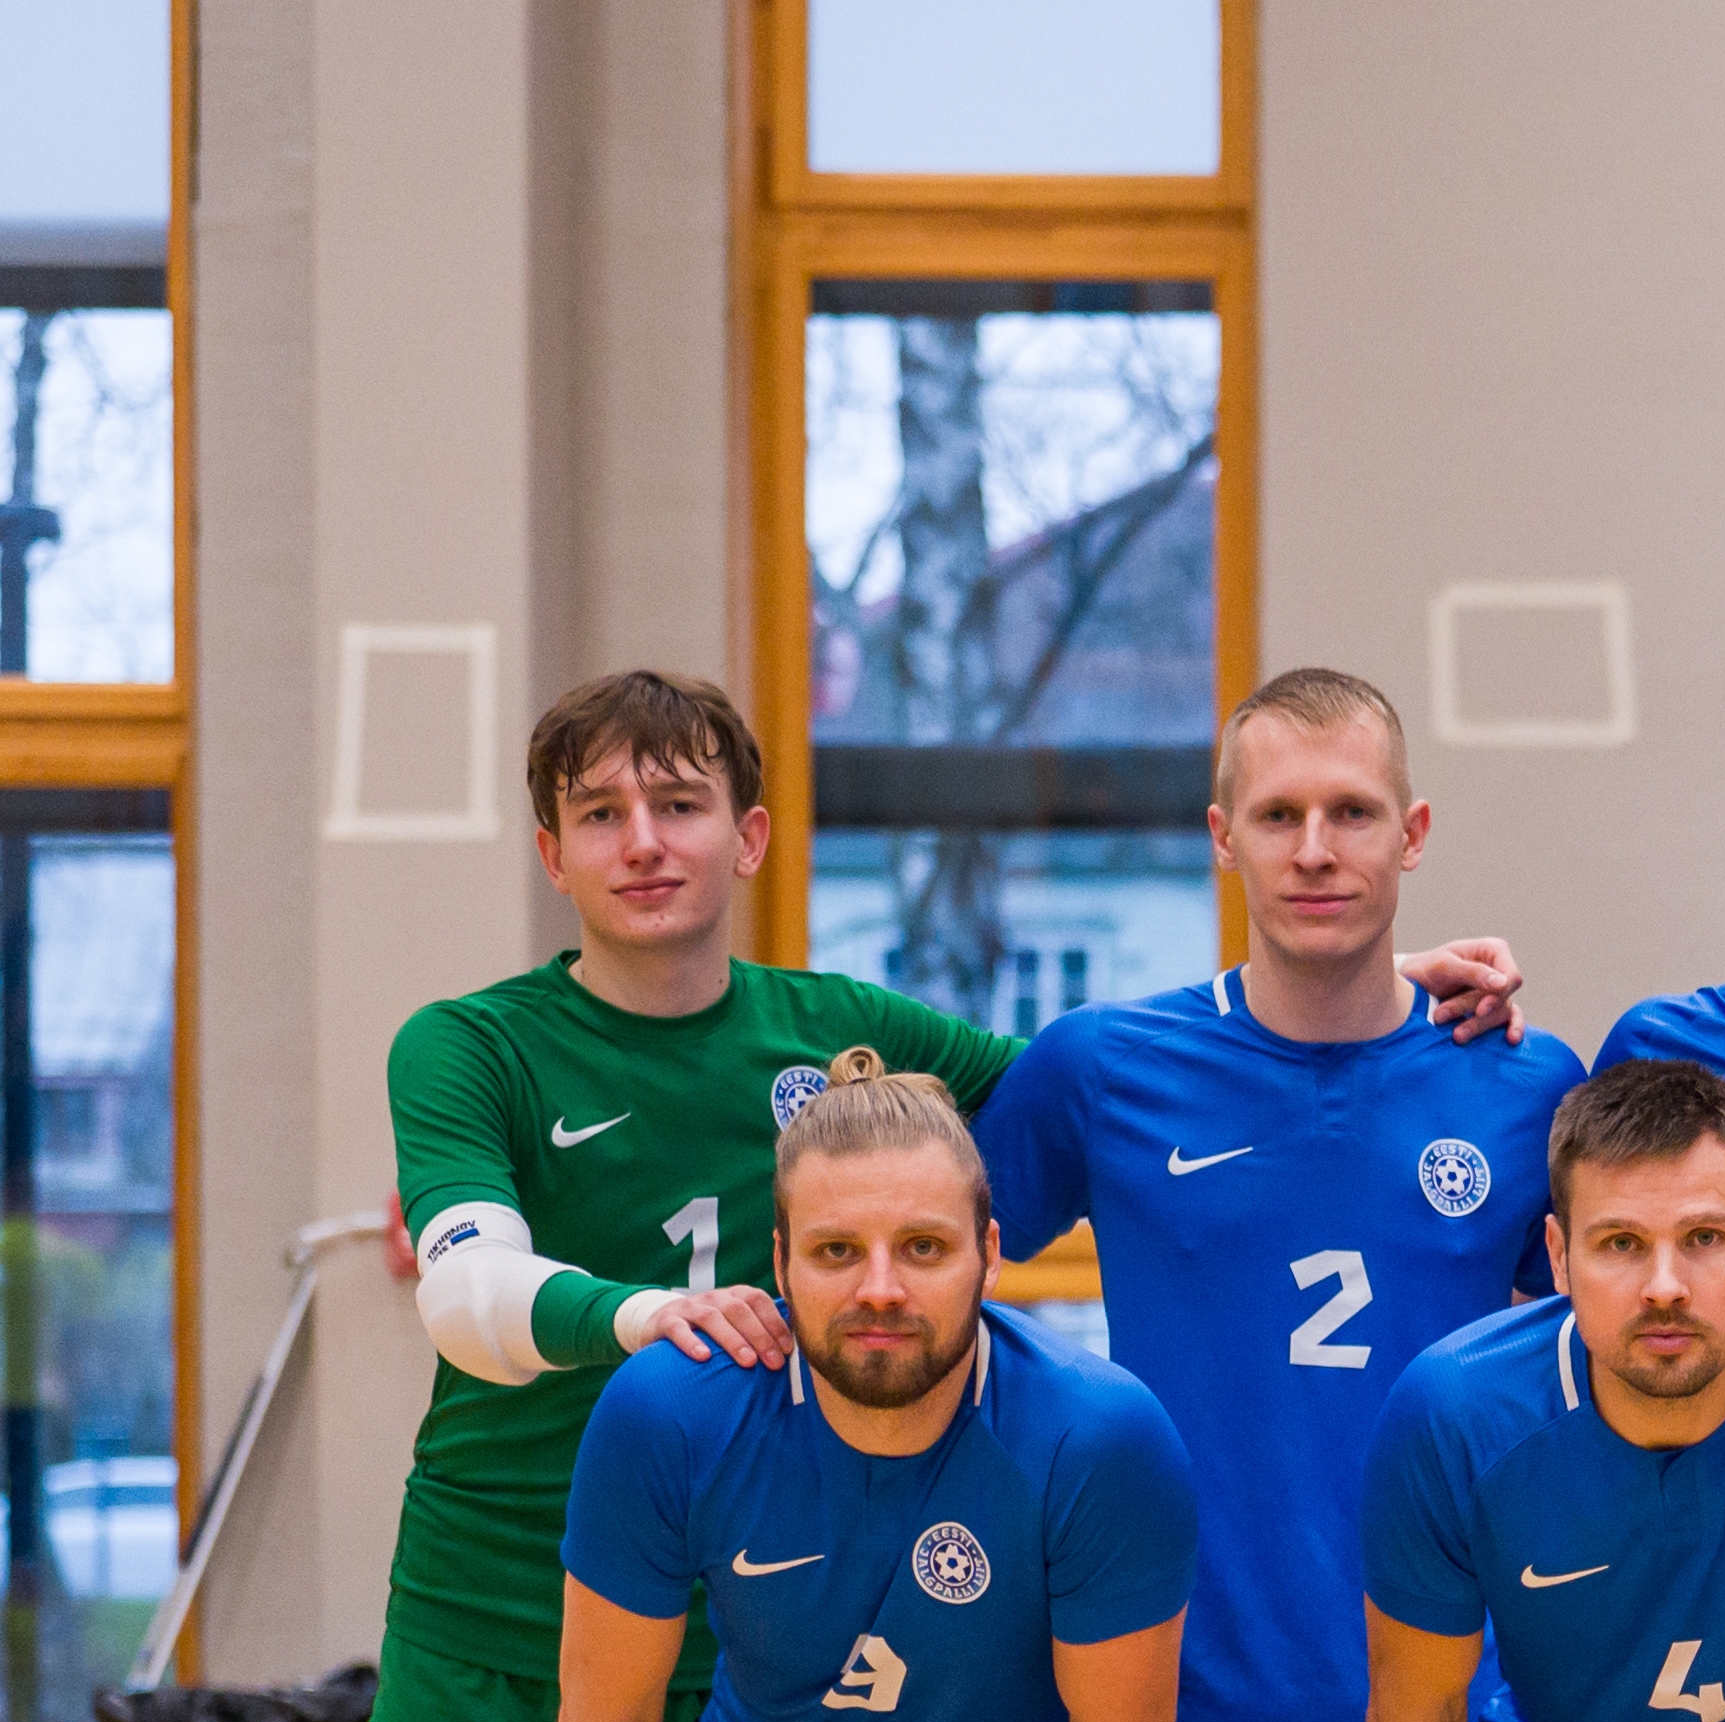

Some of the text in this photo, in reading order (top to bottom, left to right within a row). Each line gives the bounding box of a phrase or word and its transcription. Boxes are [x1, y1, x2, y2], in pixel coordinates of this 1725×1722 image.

[781, 1072, 818, 1088] EESTI
[1434, 1145, 1472, 1160] EESTI
[1423, 1162, 1473, 1211] JALGPALLI
[662, 1197, 719, 1296] 1
[1290, 1250, 1372, 1368] 2
[932, 1528, 972, 1547] EESTI
[918, 1548, 974, 1598] JALGPALLI
[822, 1635, 907, 1711] 9
